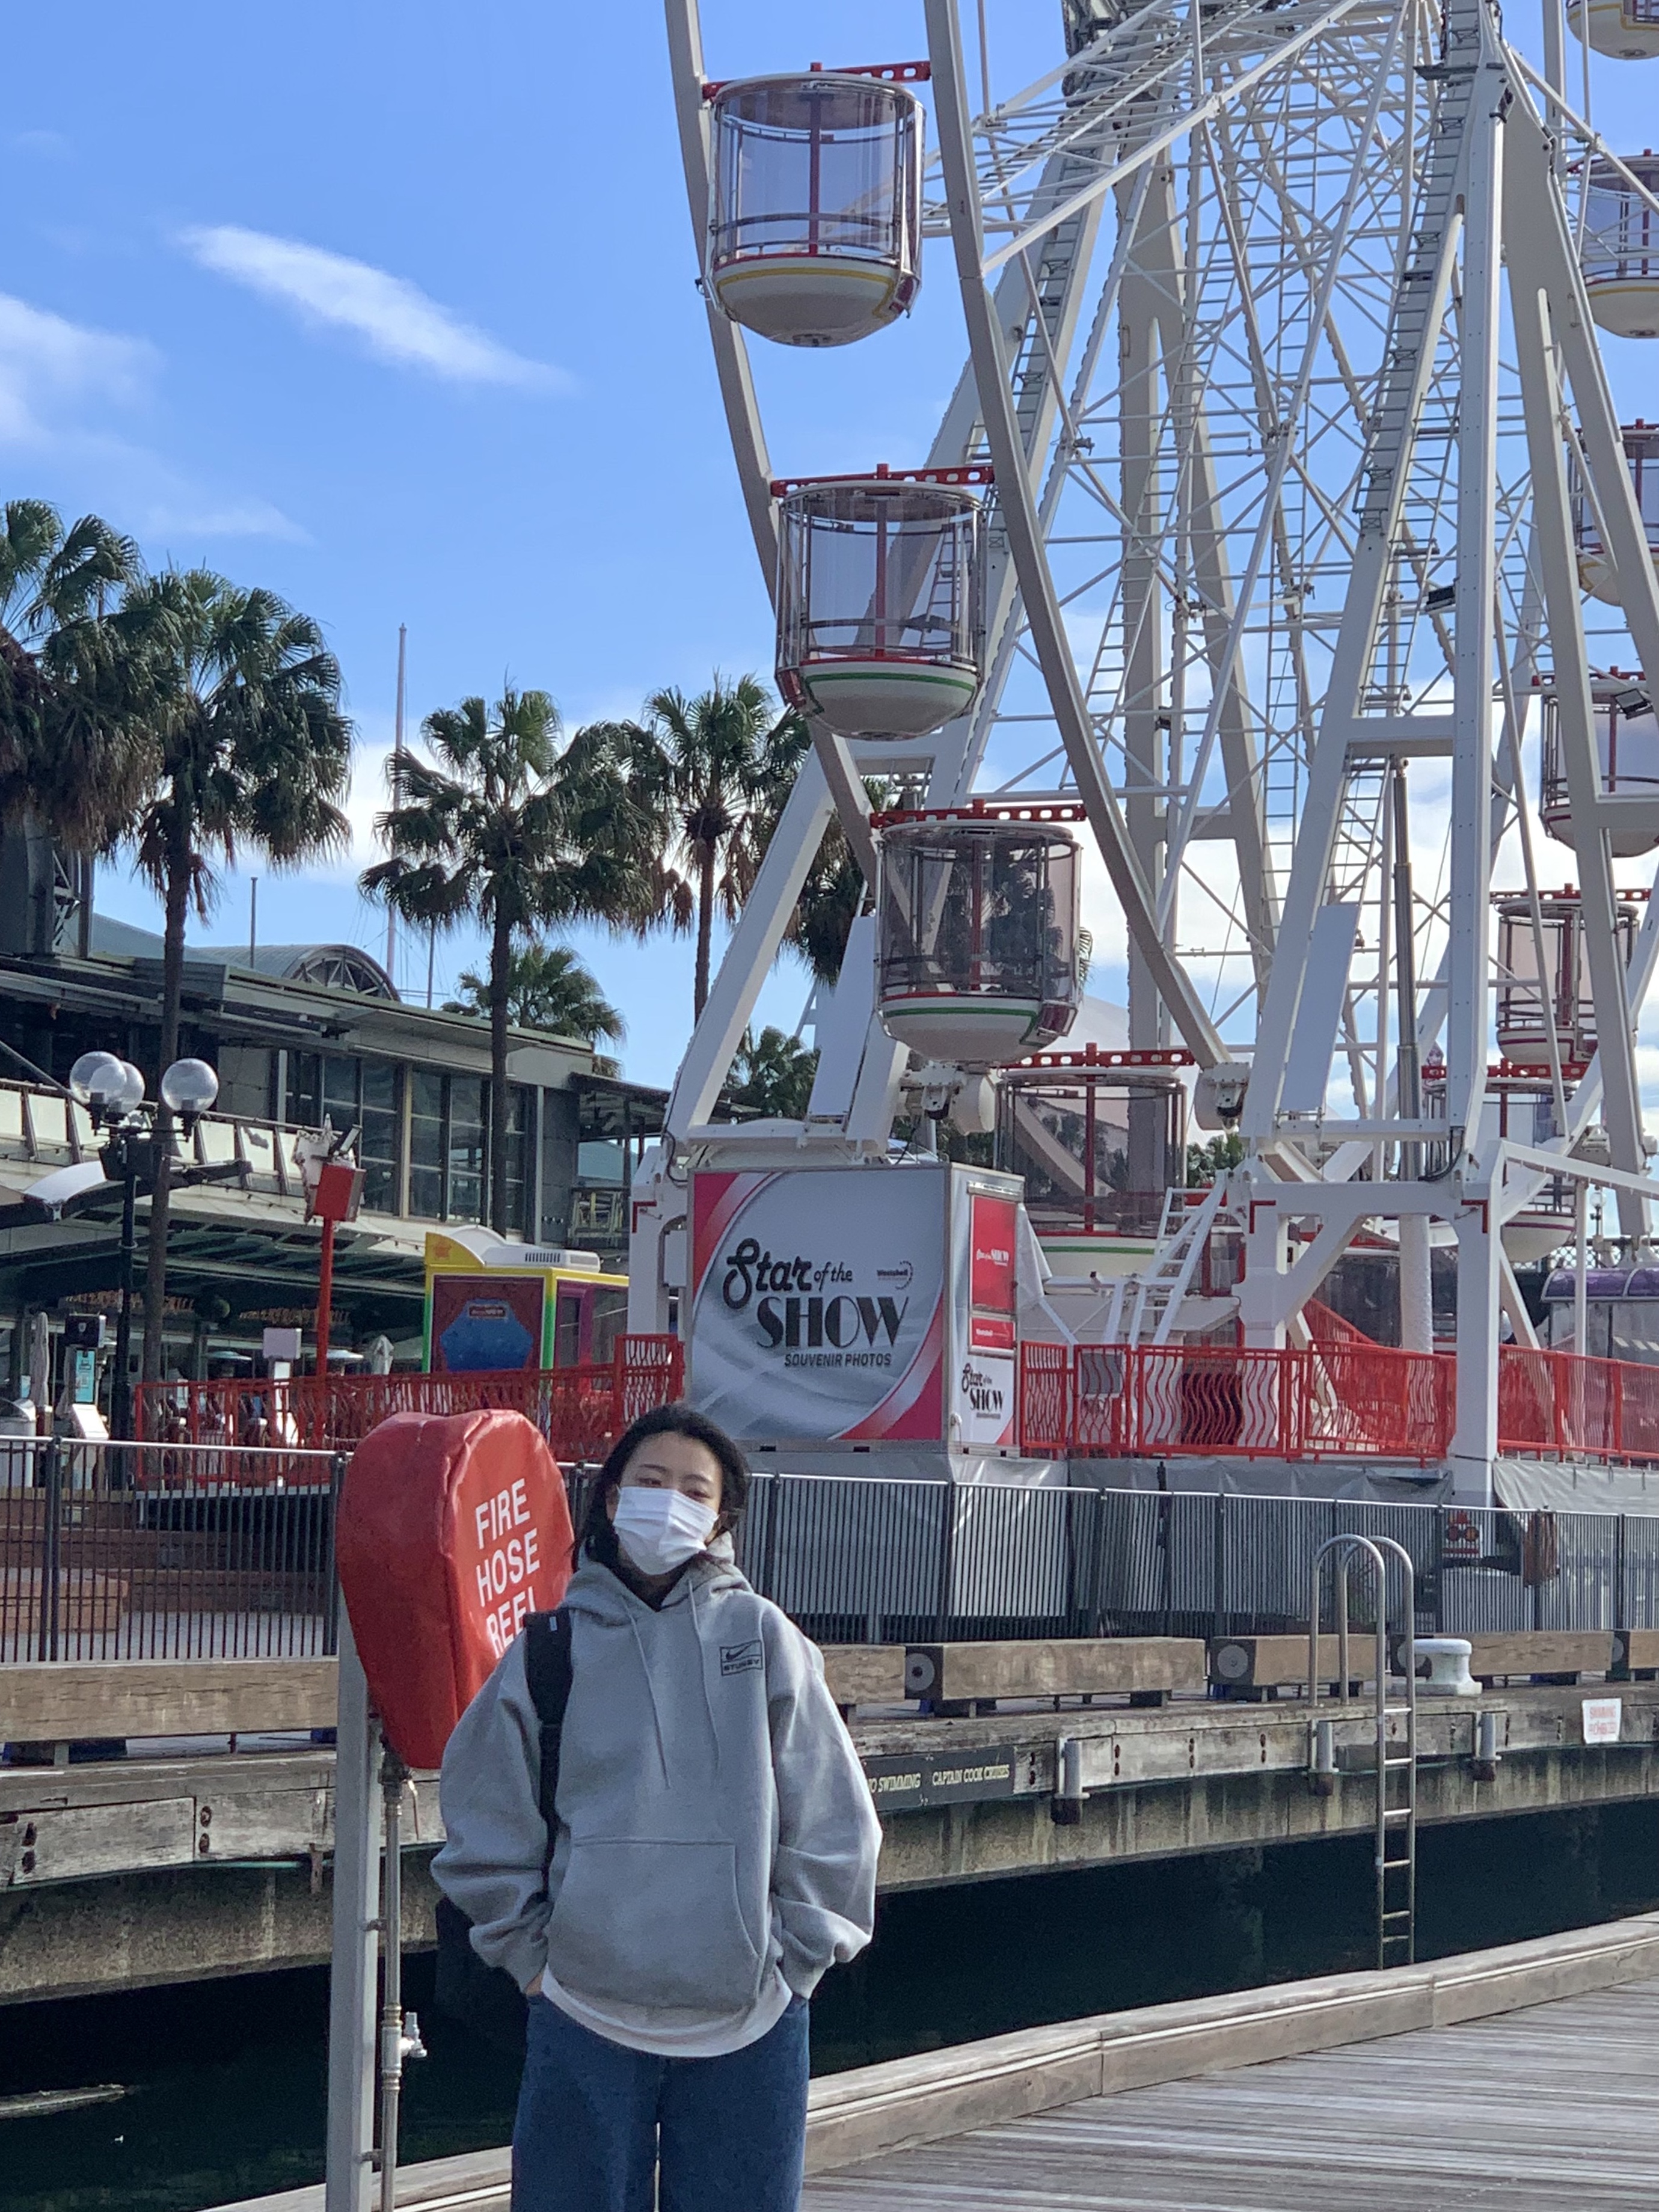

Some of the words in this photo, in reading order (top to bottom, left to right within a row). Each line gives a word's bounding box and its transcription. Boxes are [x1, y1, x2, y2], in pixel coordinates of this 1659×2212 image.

[723, 1237, 812, 1309] Star
[814, 1261, 831, 1291] of
[831, 1261, 852, 1282] the
[756, 1296, 909, 1348] SHOW
[784, 1353, 842, 1367] SOUVENIR
[845, 1353, 891, 1366] PHOTOS
[970, 1388, 1005, 1411] SHOW
[475, 1478, 530, 1549] FIRE
[476, 1528, 540, 1607] HOSE
[878, 1772, 921, 1792] SWIMMING
[933, 1769, 962, 1785] CAPTAIN
[963, 1767, 983, 1782] COOK
